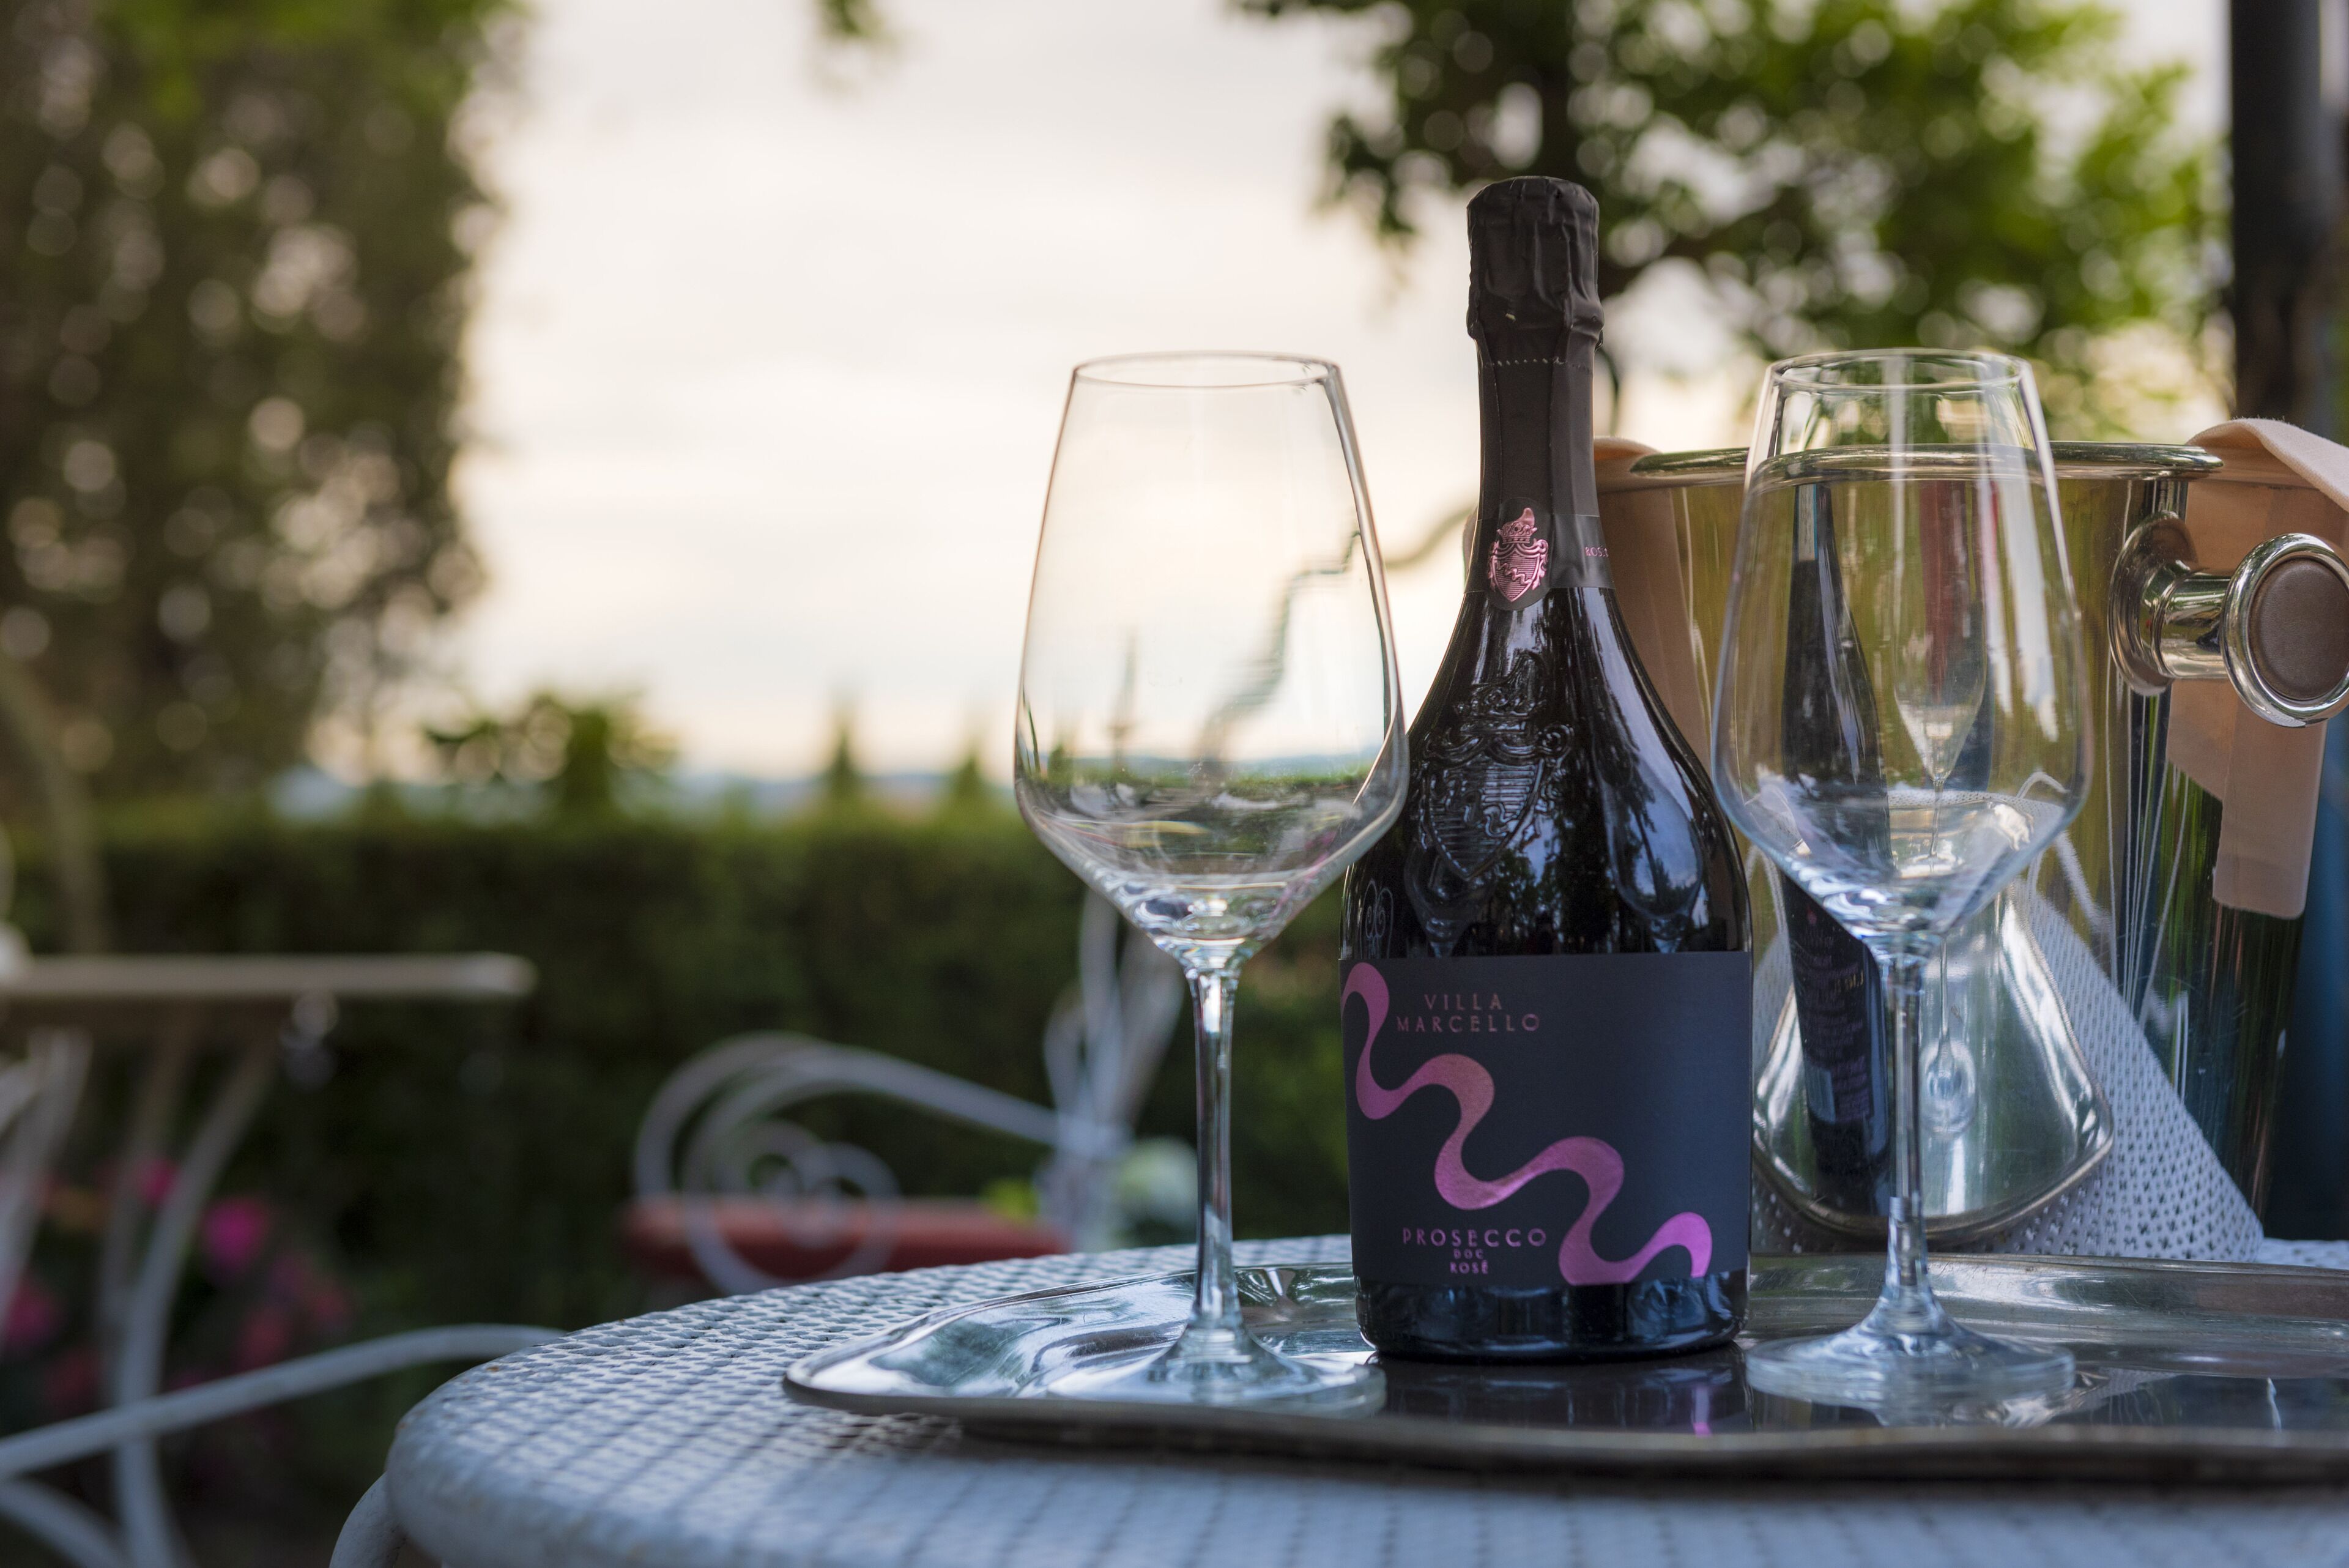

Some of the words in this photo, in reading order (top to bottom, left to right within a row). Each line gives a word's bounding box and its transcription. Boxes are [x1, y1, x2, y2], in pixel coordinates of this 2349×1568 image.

[1424, 992, 1502, 1010] VILLA
[1397, 1013, 1540, 1033] MARCELLO
[1403, 1227, 1546, 1247] PROSECCO
[1453, 1249, 1484, 1259] DOC
